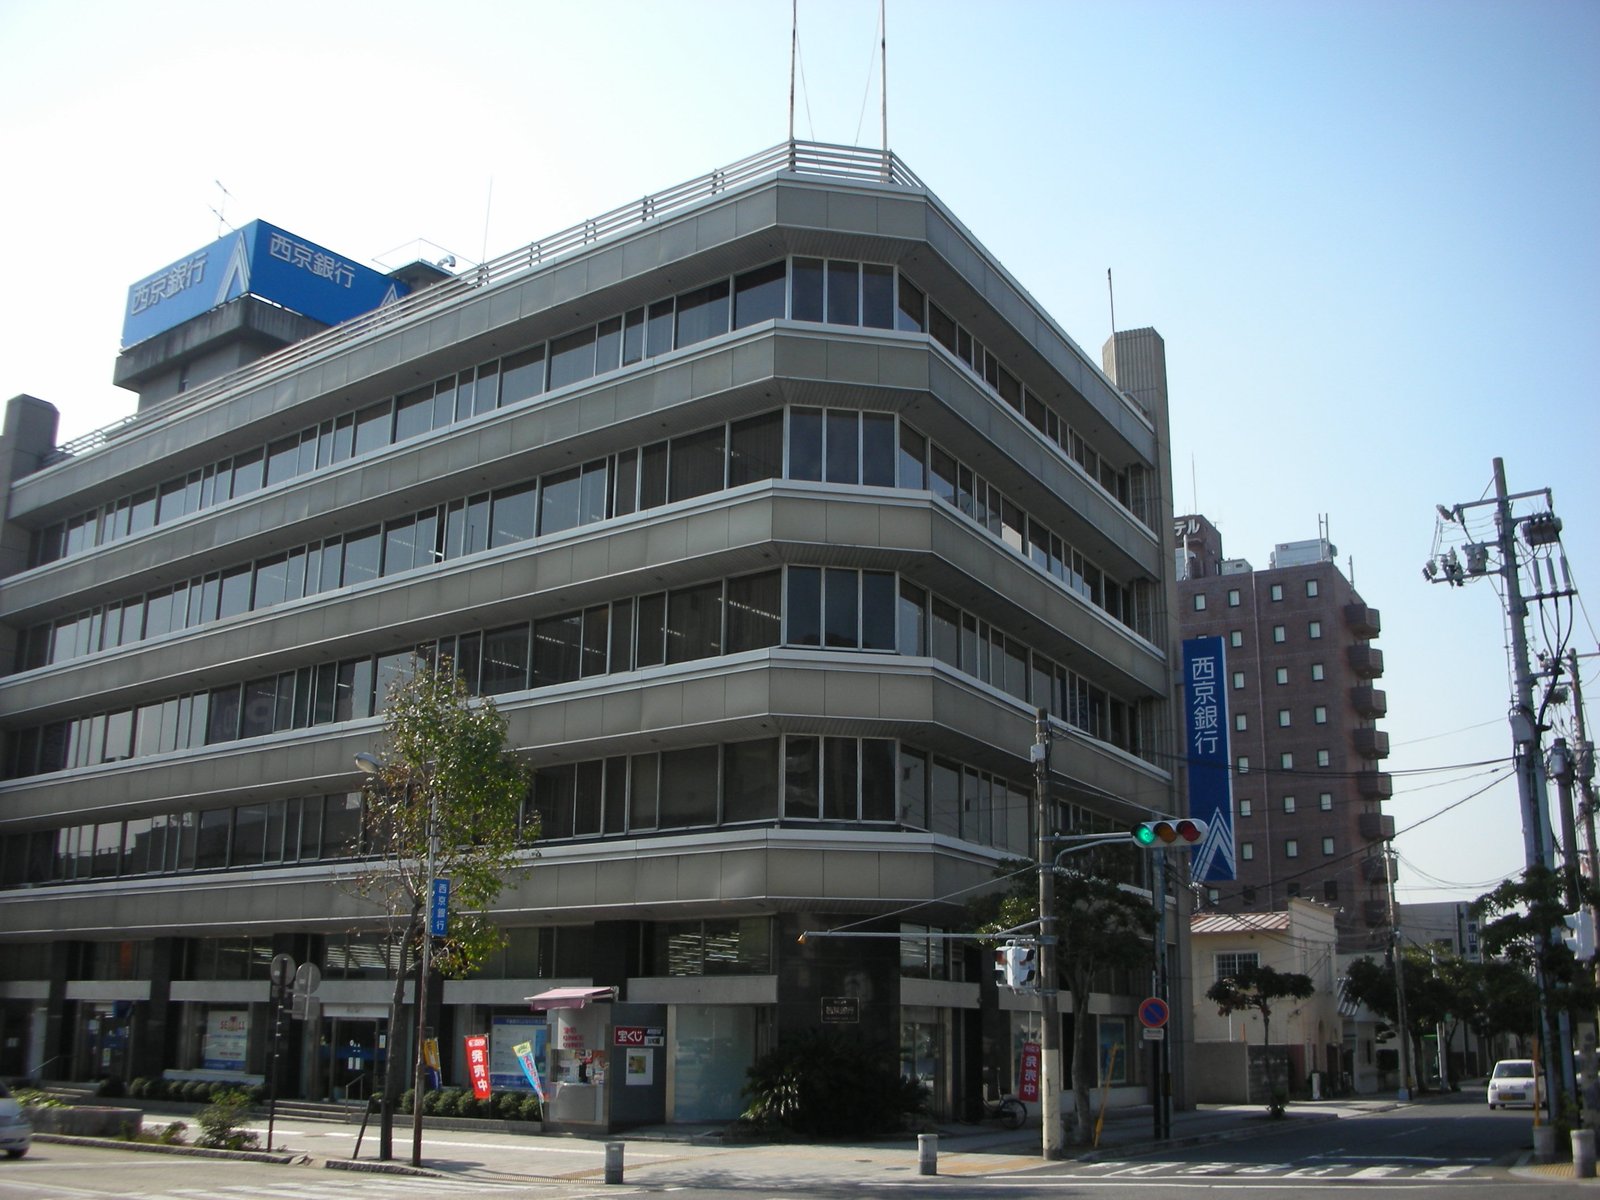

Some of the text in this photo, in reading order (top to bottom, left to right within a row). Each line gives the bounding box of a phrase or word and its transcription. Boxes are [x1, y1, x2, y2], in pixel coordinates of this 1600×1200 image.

[131, 251, 209, 316] 西京銀行
[270, 232, 356, 289] 西京銀行
[1191, 656, 1219, 755] 西京銀行
[436, 883, 448, 931] 西京銀行
[617, 1030, 643, 1042] 宝くじ
[471, 1049, 488, 1092] 発売中
